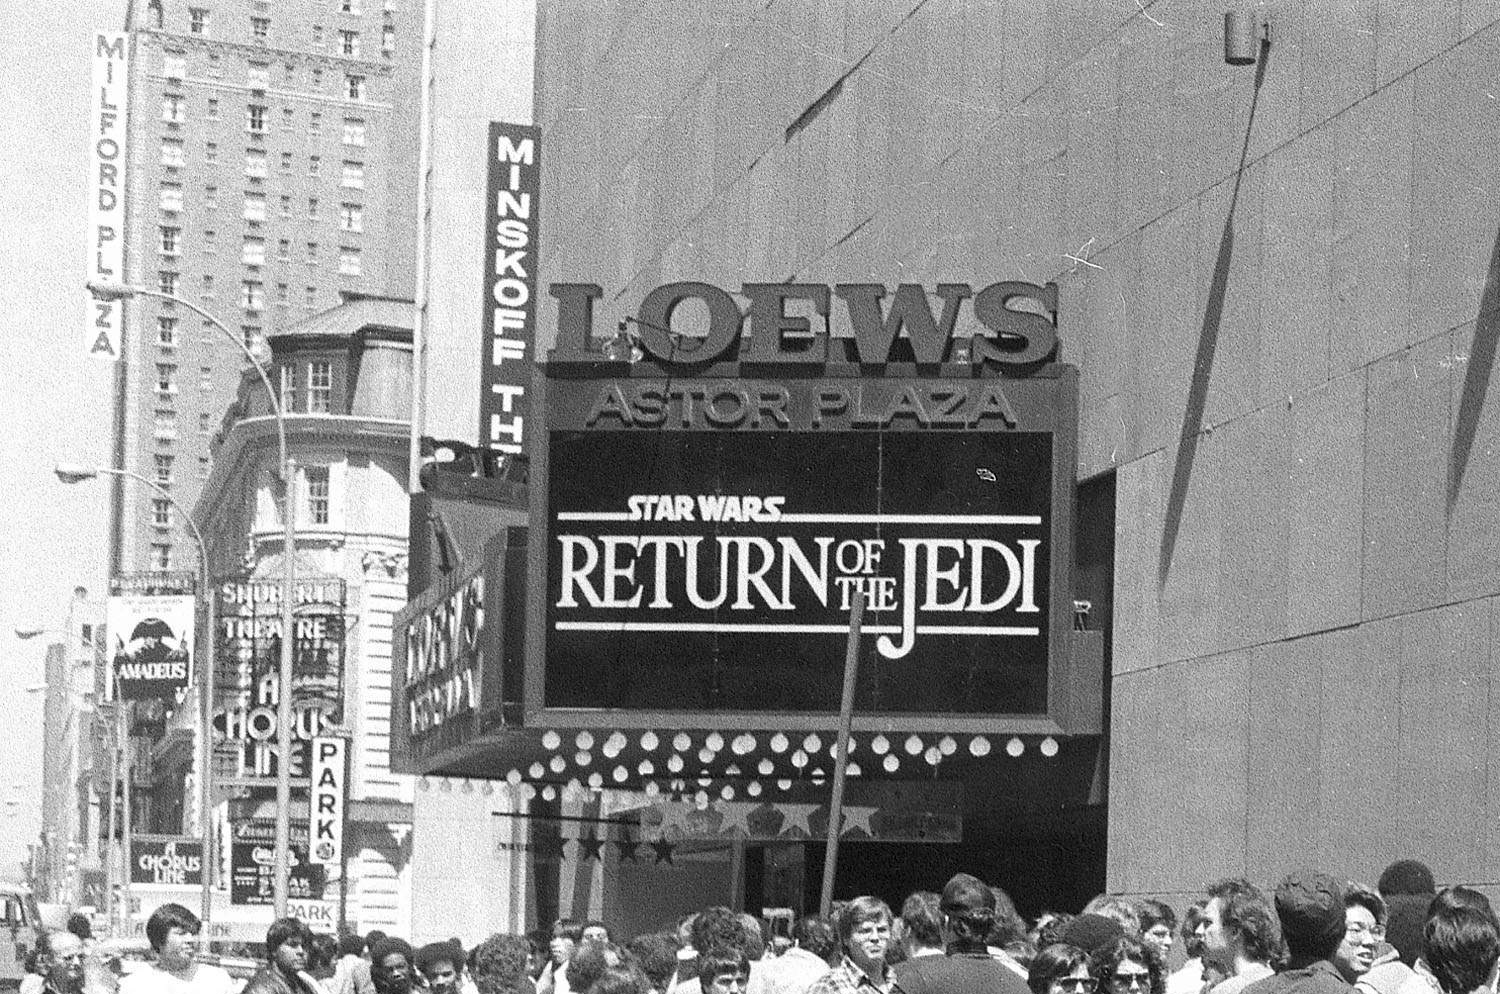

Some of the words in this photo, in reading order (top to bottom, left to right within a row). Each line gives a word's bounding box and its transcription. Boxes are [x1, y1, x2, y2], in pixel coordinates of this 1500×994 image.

[96, 34, 124, 212] MILFORD
[492, 136, 535, 366] MINSKOFF
[90, 225, 116, 355] PLZA
[547, 281, 1060, 376] LOEWS
[585, 383, 791, 428] ASTOR
[811, 384, 1016, 429] PLAZA
[627, 495, 696, 521] STAR
[697, 495, 787, 522] WARS
[555, 535, 835, 610] RETURN
[835, 539, 886, 574] OF
[222, 583, 326, 604] SHUBRT
[834, 576, 898, 611] THE
[876, 538, 1042, 659] JEDI
[222, 618, 327, 639] THEARE
[118, 662, 188, 680] AMADEUS
[258, 671, 280, 705] A
[317, 742, 338, 840] PARK
[138, 854, 201, 872] CHORUS
[153, 868, 187, 883] LINE
